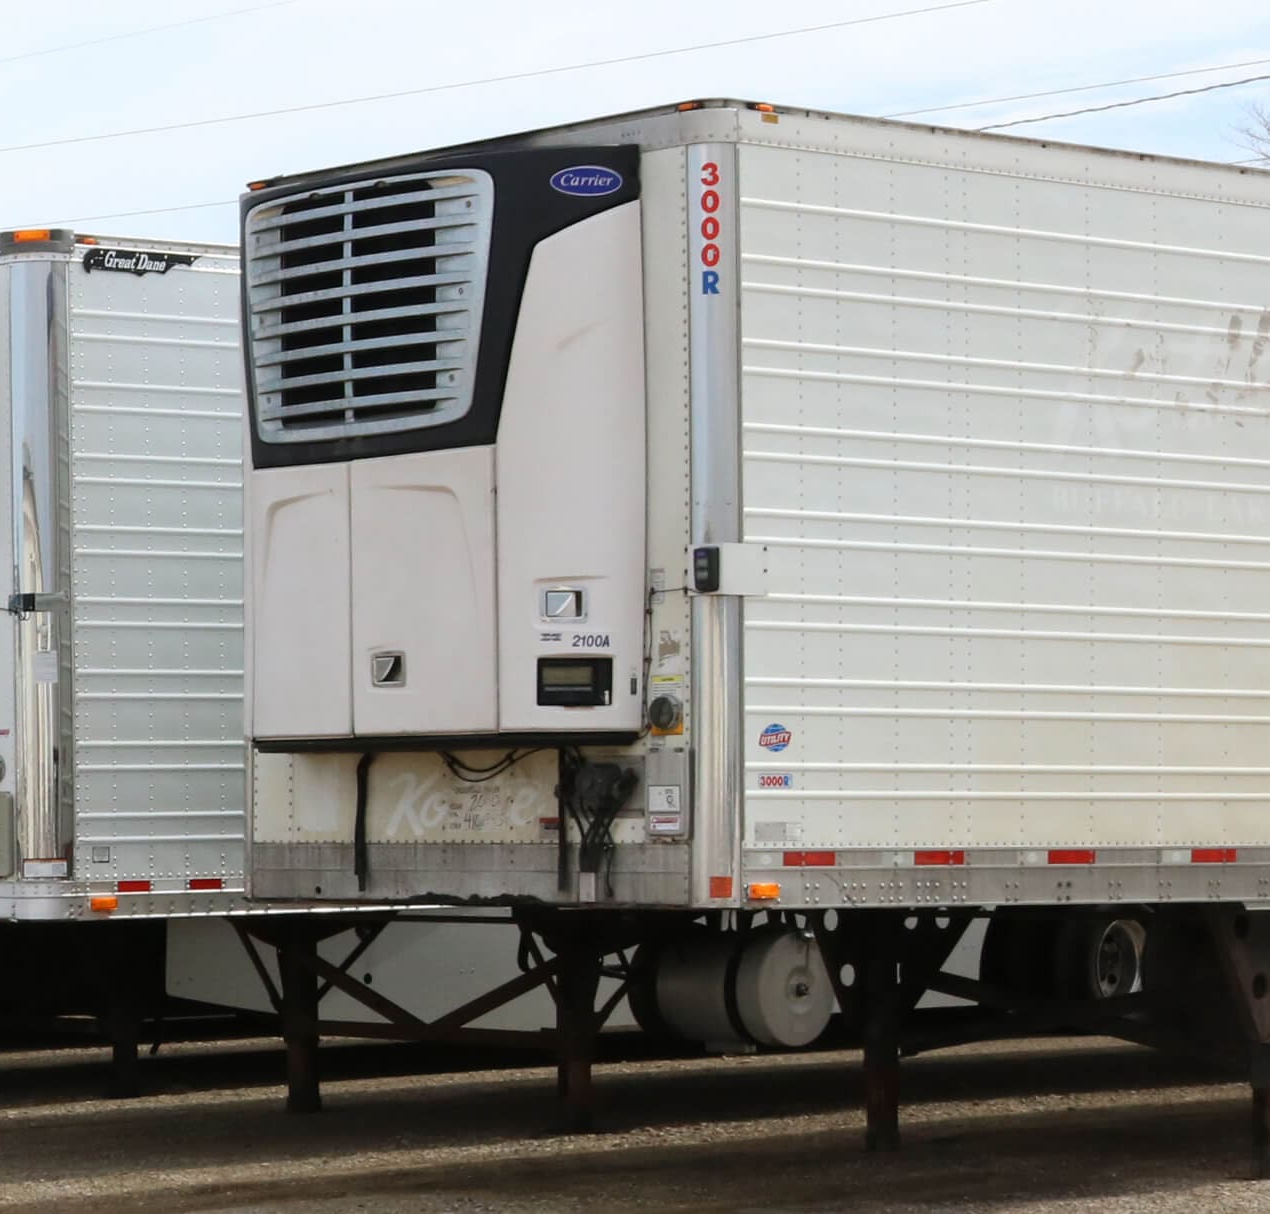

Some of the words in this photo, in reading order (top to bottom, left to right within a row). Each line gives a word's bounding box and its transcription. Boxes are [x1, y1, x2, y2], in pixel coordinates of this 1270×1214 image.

[560, 173, 614, 187] Carrier
[701, 162, 720, 295] 3000R
[104, 250, 136, 271] Great
[136, 253, 167, 272] Dane
[572, 634, 610, 648] 2100A
[760, 732, 790, 746] UTILITY
[760, 775, 790, 787] 3000R
